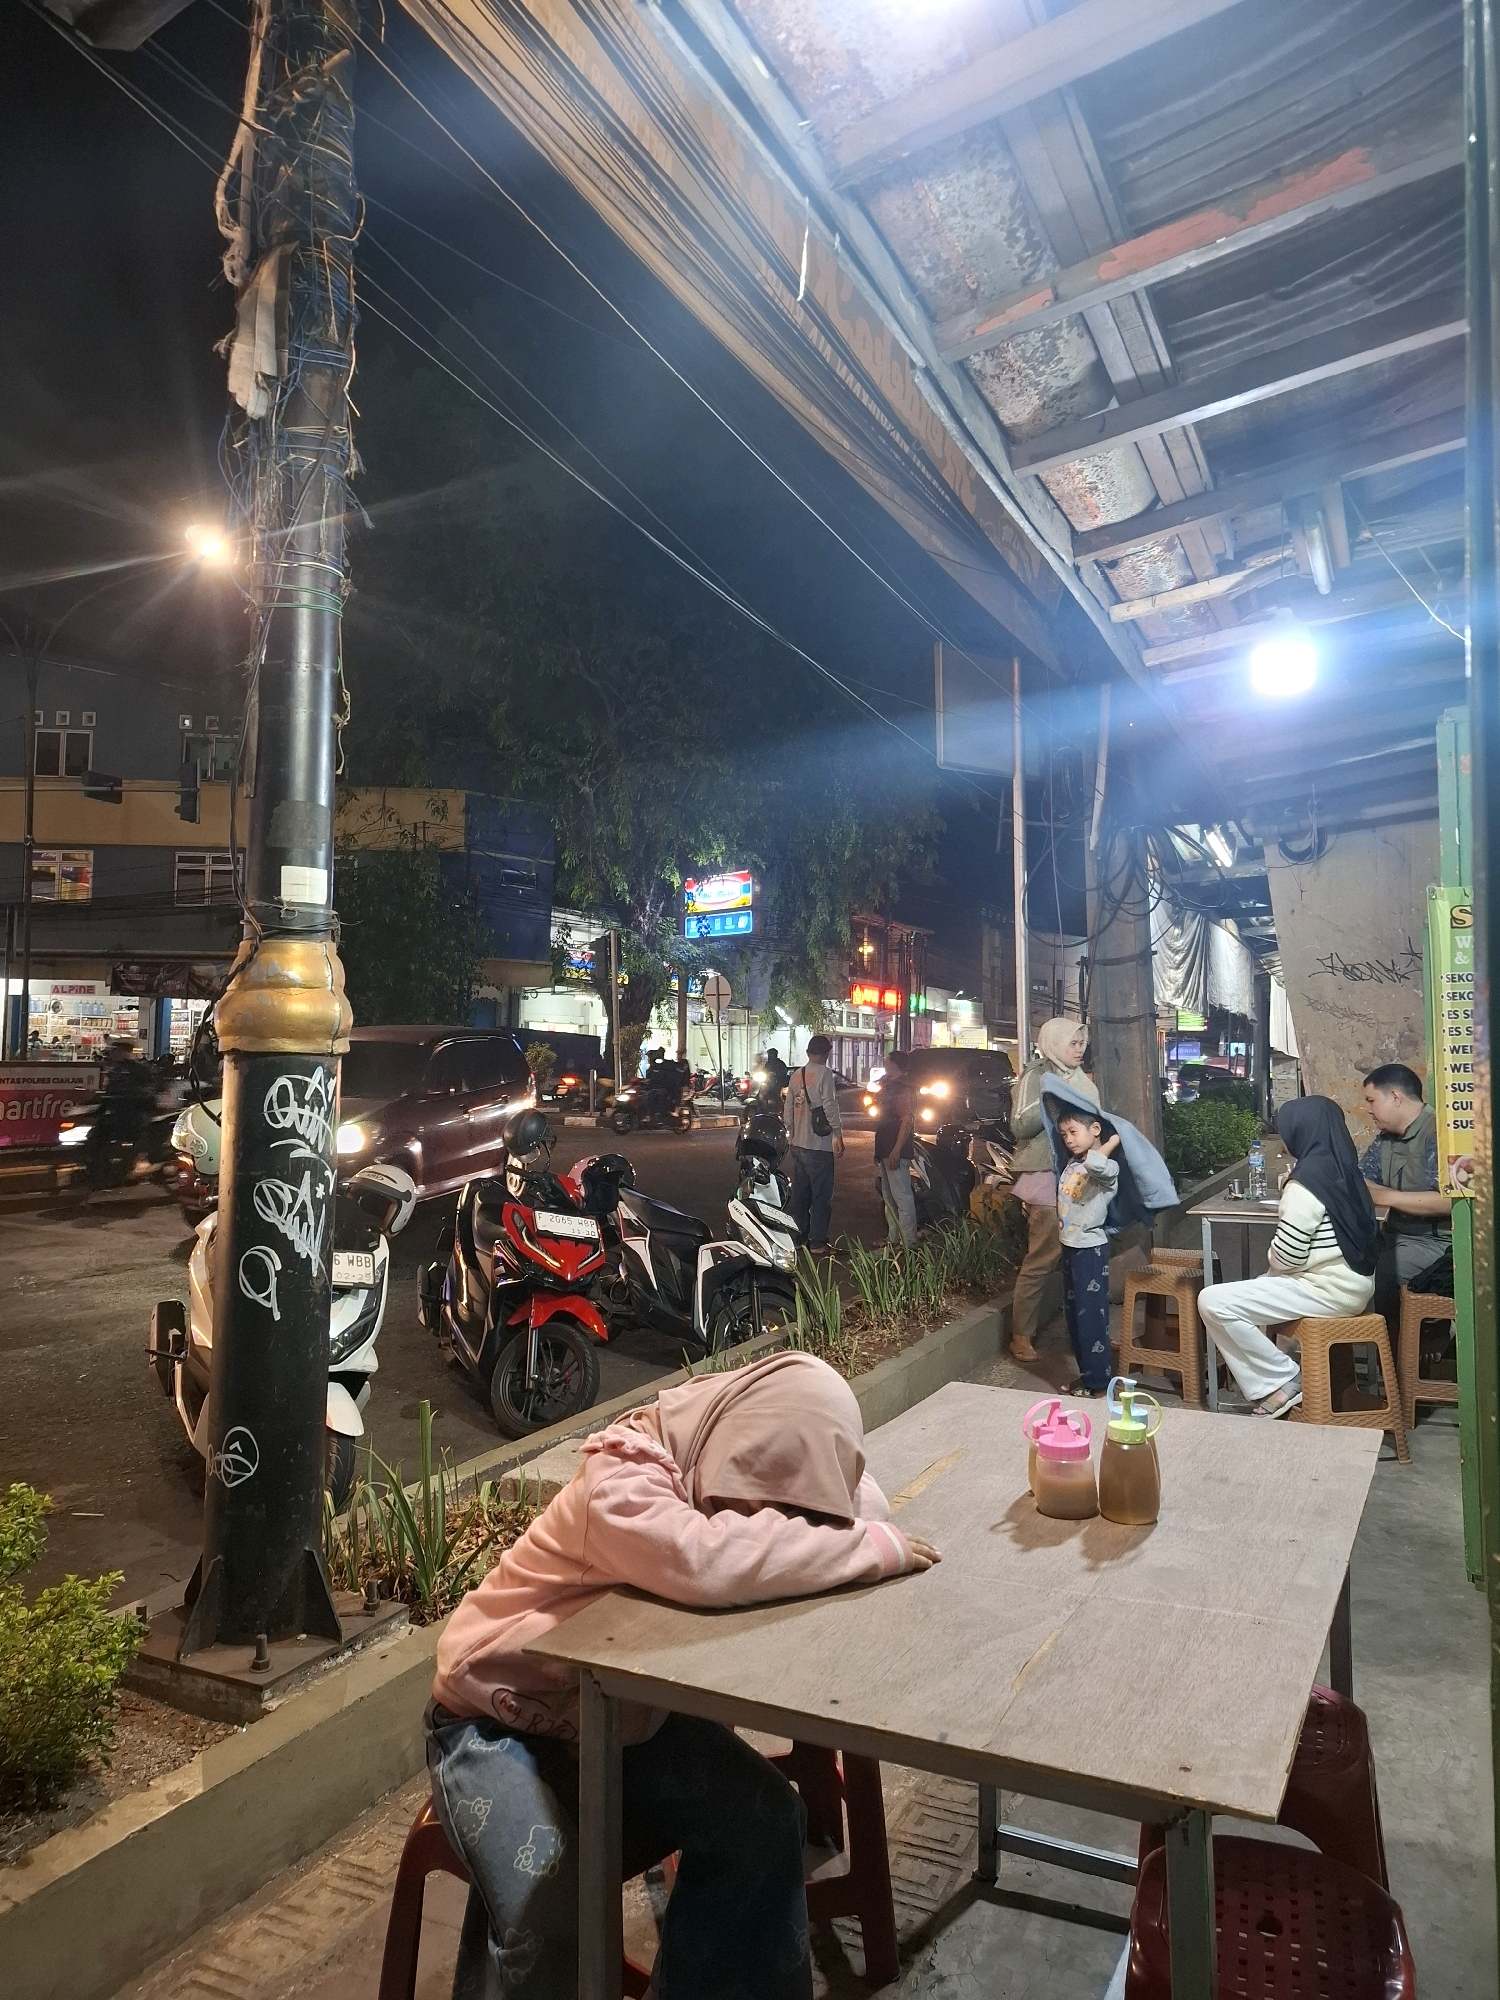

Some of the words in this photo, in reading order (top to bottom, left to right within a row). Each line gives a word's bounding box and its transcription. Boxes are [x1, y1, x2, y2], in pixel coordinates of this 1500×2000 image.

[1454, 951, 1470, 965] &
[1447, 1010, 1460, 1019] ES
[1448, 1027, 1462, 1036] ES
[537, 1212, 543, 1221] F
